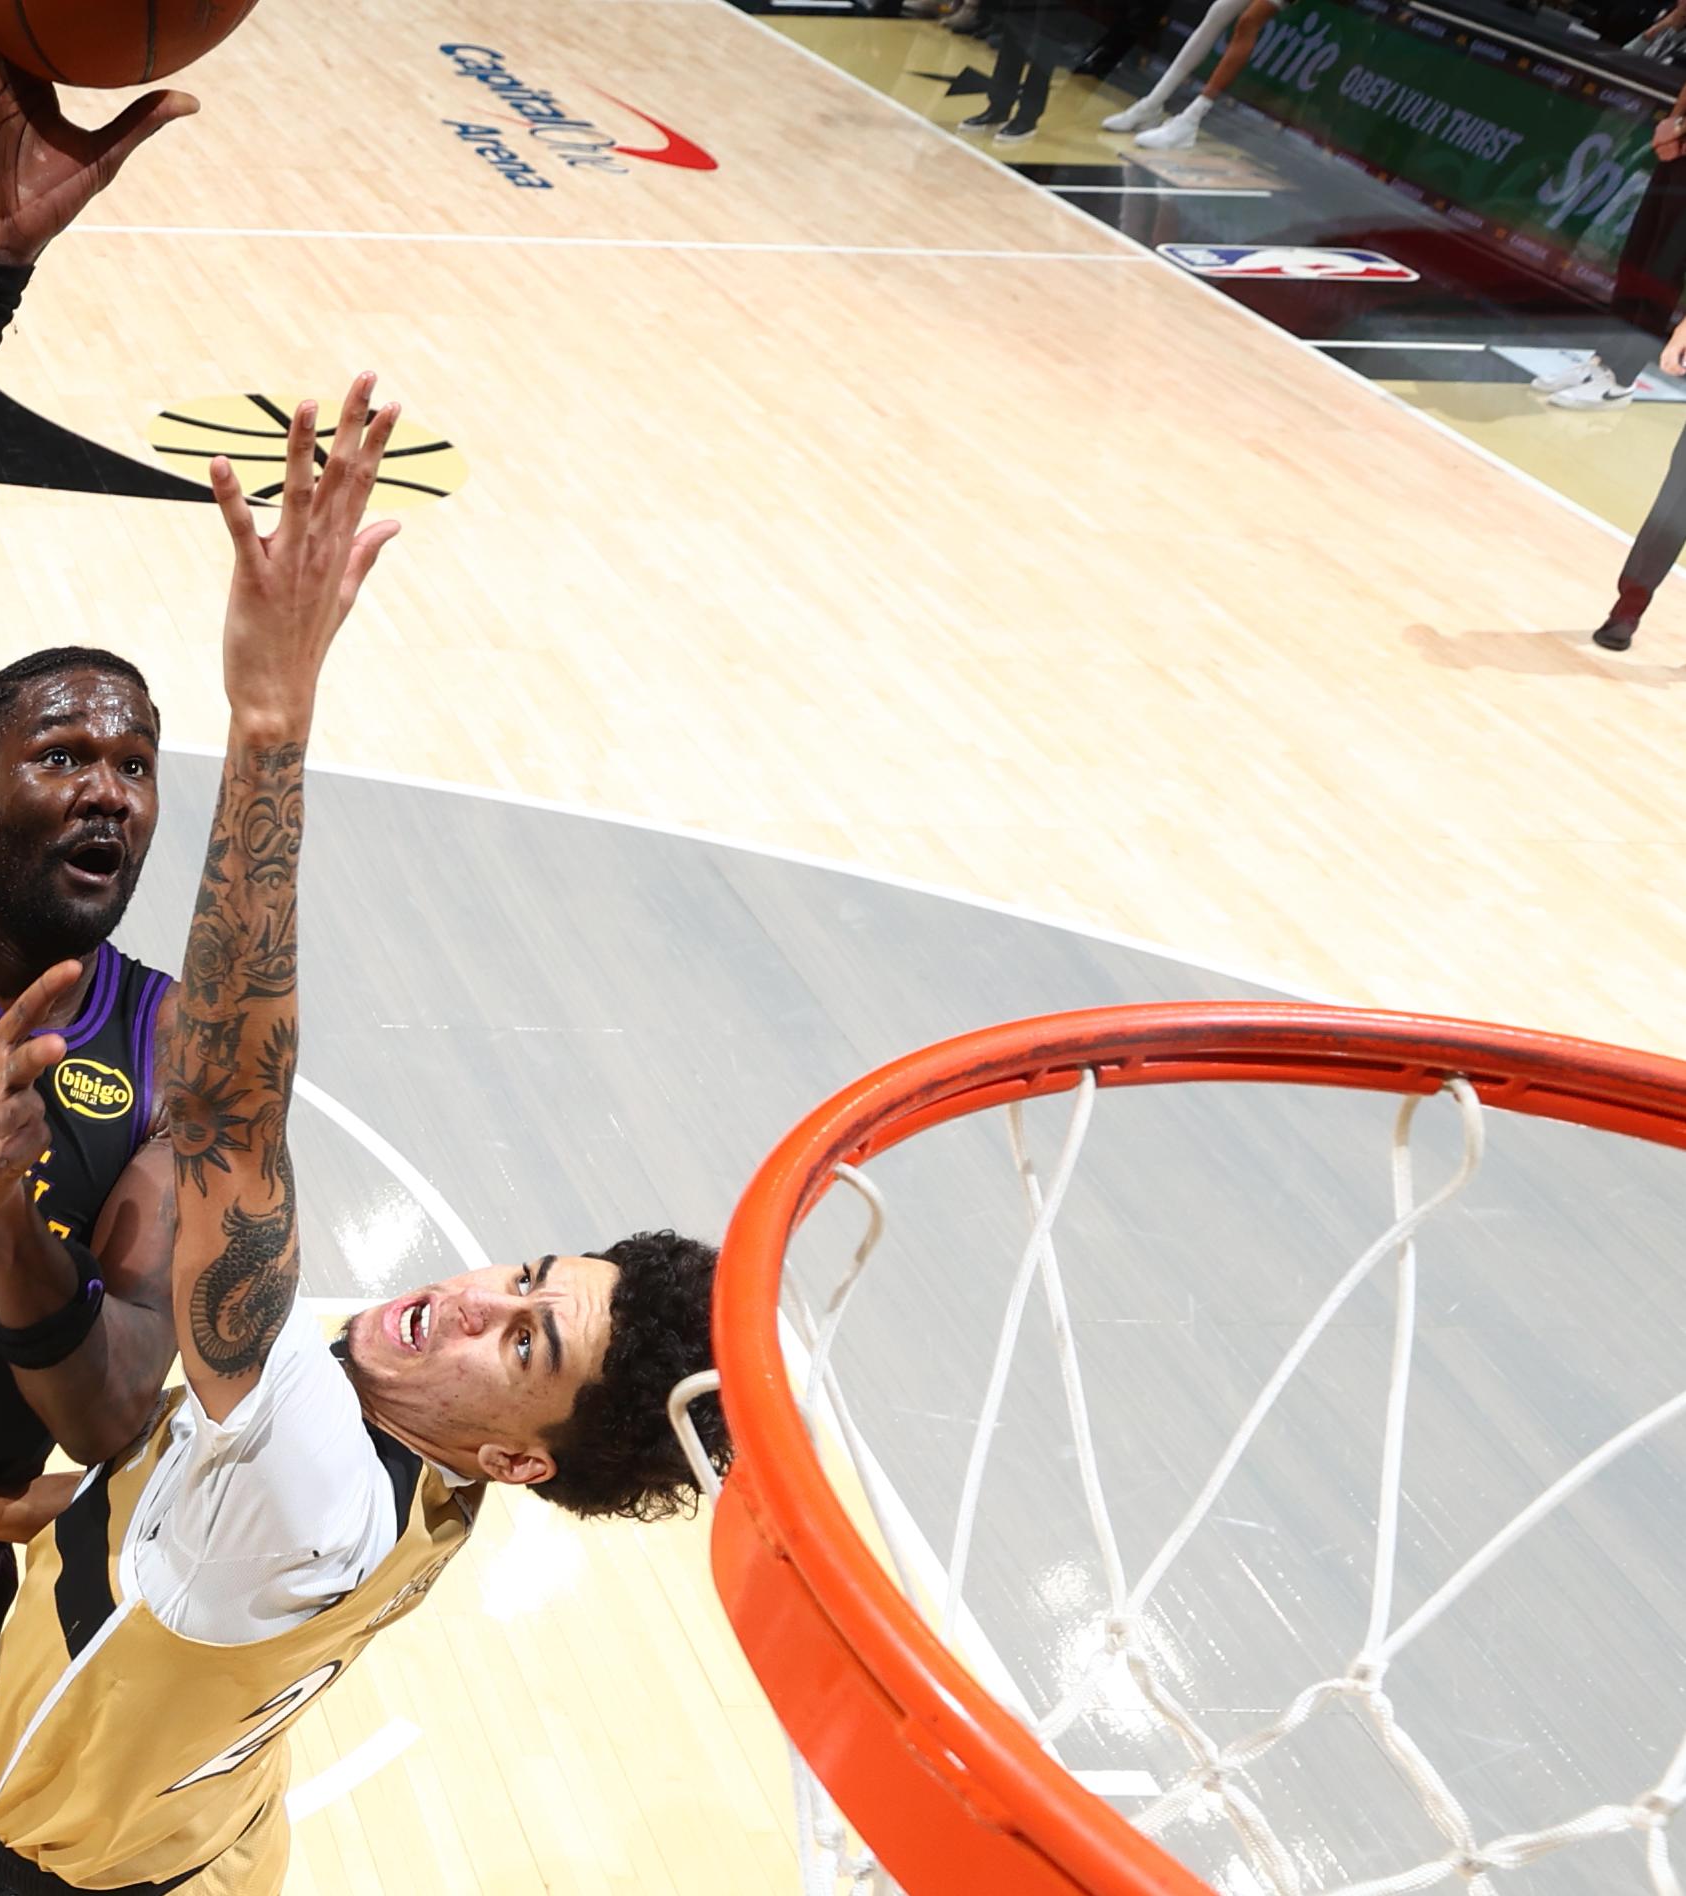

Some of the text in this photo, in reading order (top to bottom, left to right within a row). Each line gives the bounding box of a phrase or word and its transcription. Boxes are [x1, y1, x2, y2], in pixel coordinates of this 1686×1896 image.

[1213, 11, 1341, 91] rite
[1339, 64, 1525, 164] OBEY YOUR THIRST
[442, 119, 553, 188] Arena
[62, 1066, 128, 1105] bibigo
